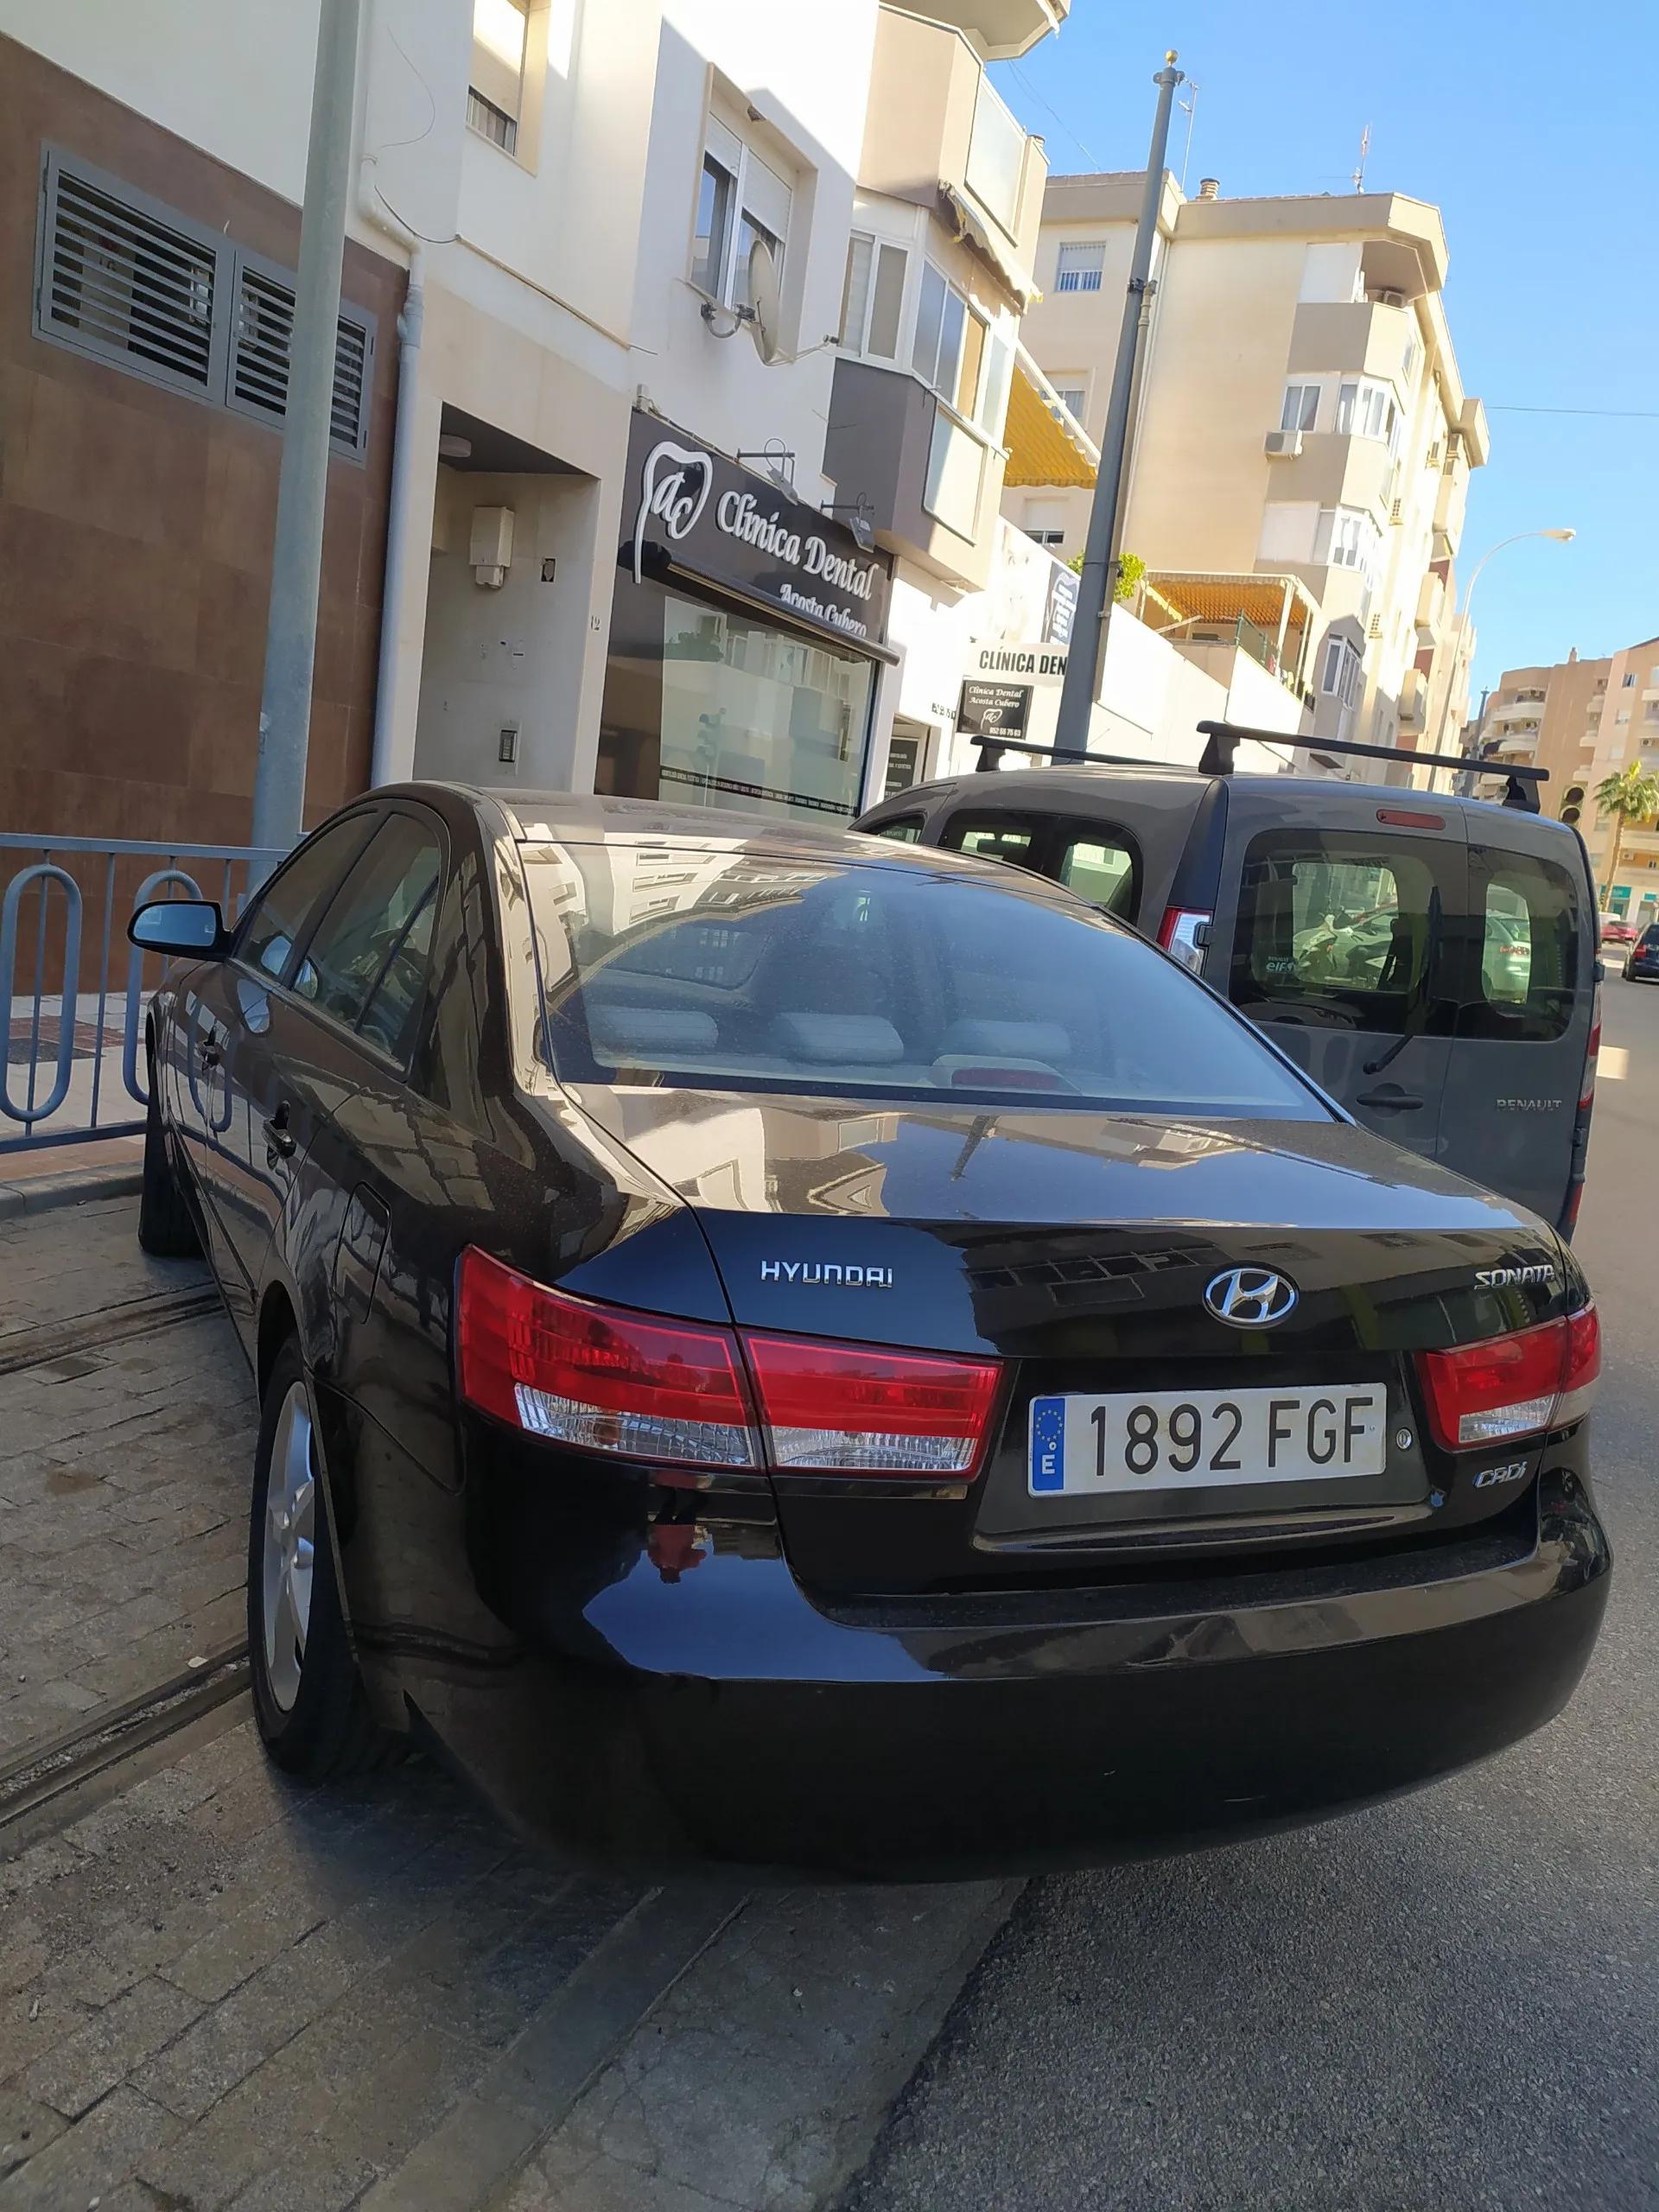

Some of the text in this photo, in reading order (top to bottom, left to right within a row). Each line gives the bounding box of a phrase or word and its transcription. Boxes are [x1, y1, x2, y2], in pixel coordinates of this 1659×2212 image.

[716, 490, 880, 601] Clínica Dental
[590, 614, 601, 631] 12
[979, 645, 1068, 676] CLÍNICA DEN
[995, 689, 1024, 698] Dental
[1497, 1098, 1562, 1112] RENAULT
[760, 1260, 893, 1288] HYUNDAI
[1473, 1264, 1555, 1290] SONATA
[1090, 1402, 1242, 1477] 1892
[1268, 1396, 1374, 1468] FGF
[1042, 1454, 1056, 1475] E
